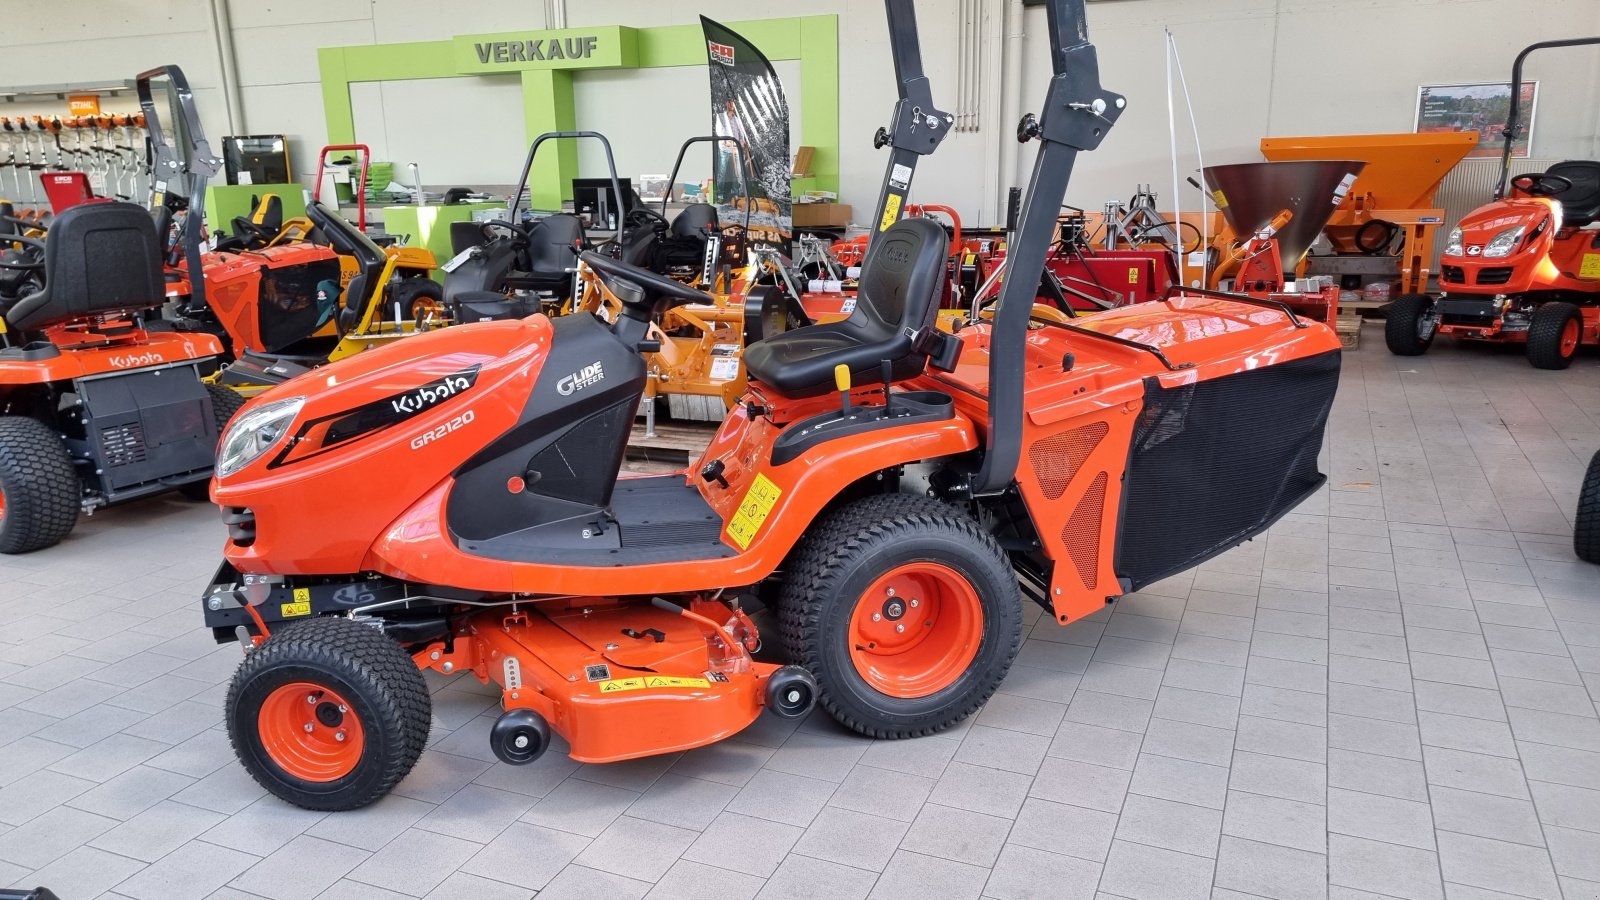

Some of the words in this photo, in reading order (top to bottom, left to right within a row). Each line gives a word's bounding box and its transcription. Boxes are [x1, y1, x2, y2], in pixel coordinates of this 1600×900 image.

[474, 36, 597, 64] VERKAUF
[71, 101, 94, 110] STIHL
[109, 352, 164, 368] Kubota
[556, 360, 604, 396] GLIDE
[576, 372, 605, 391] STEER
[391, 377, 470, 414] Kubota
[410, 409, 475, 450] GR2120
